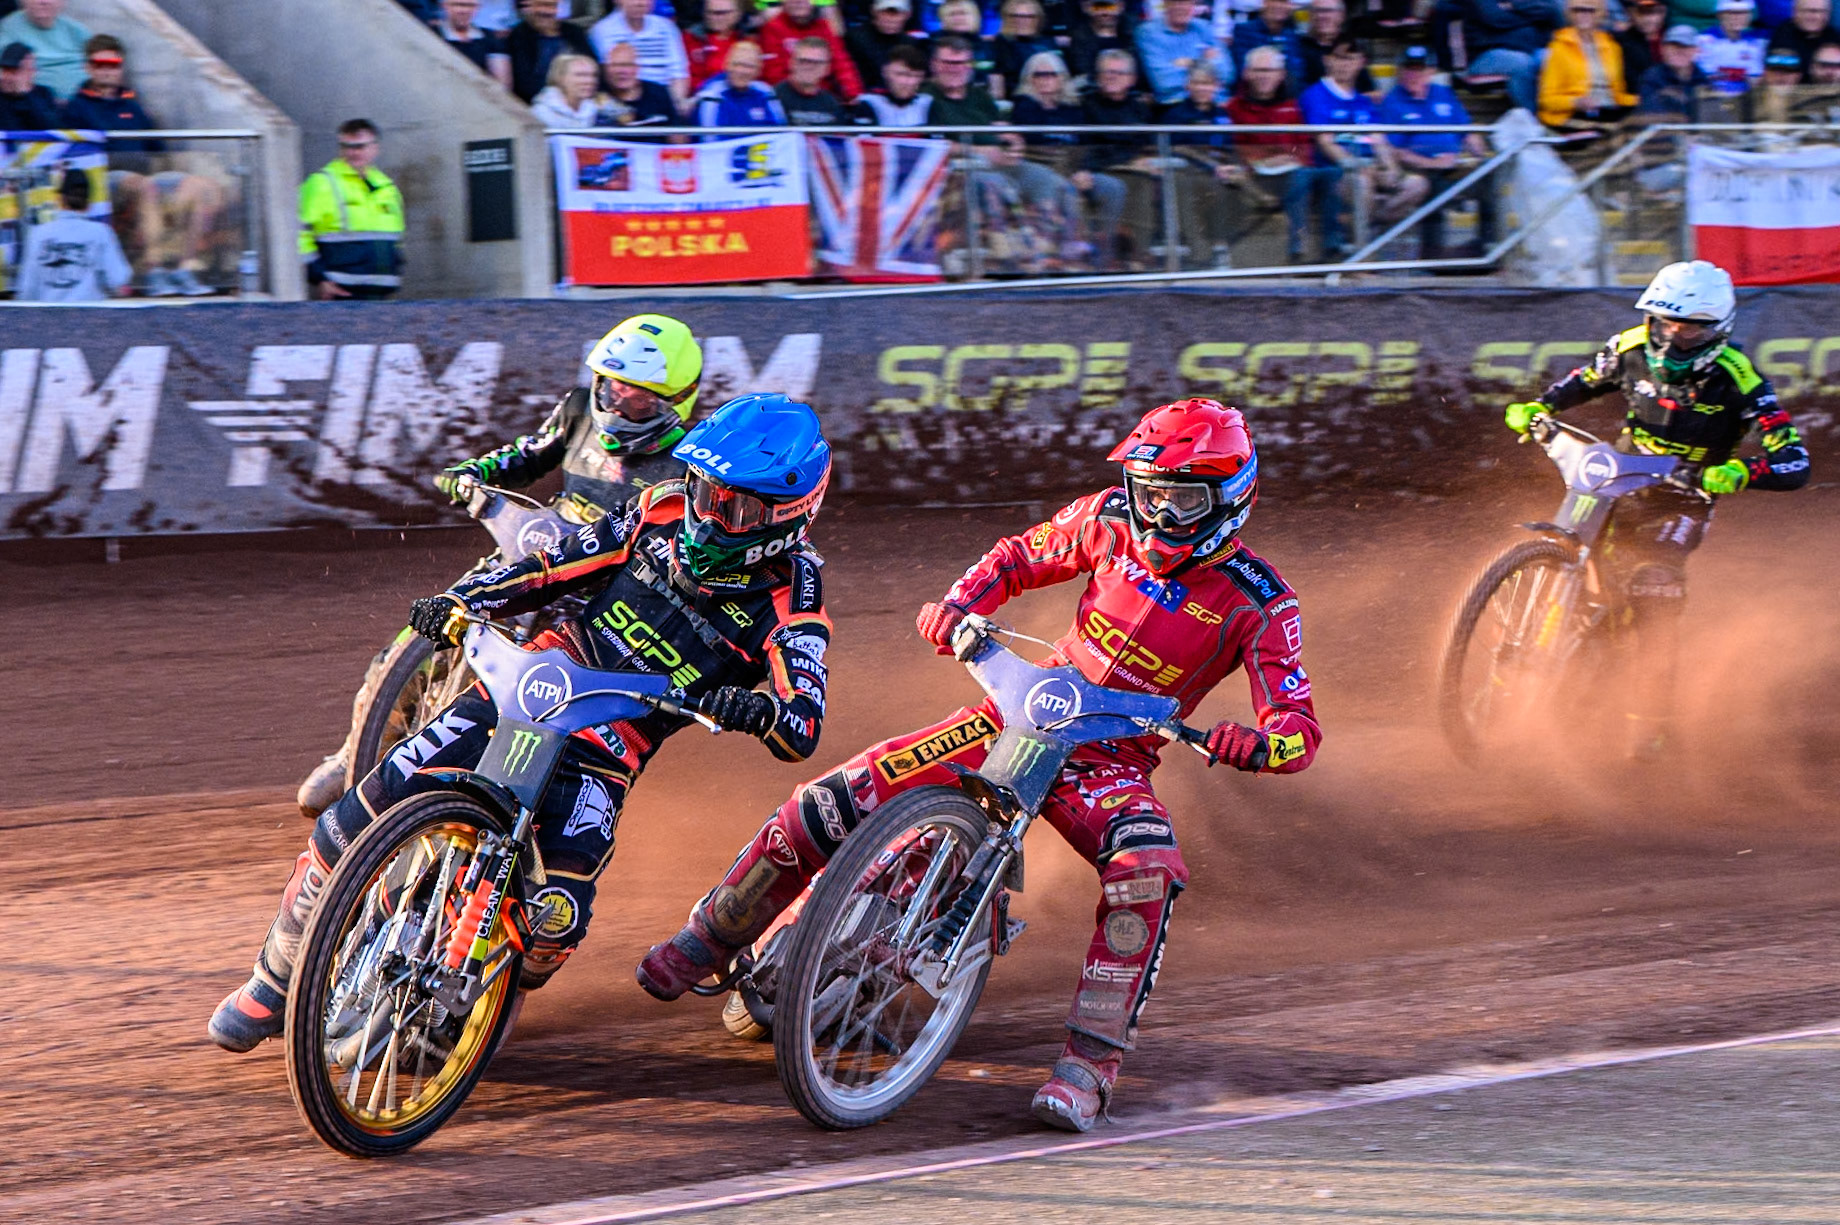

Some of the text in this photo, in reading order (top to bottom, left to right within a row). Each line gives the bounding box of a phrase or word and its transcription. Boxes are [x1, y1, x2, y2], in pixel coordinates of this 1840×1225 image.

[610, 233, 748, 257] POLSKA
[190, 341, 504, 487] FIM
[676, 443, 733, 475] BOLL
[776, 497, 806, 517] OPTY
[745, 524, 807, 566] BOLL
[601, 627, 633, 659] SPEEDWAY
[525, 679, 564, 703] ATPI
[1114, 666, 1143, 687] GRAND
[1032, 692, 1072, 716] ATPI
[917, 717, 988, 762] ENTRAC
[773, 833, 794, 860] ATPI
[477, 889, 501, 938] CLEAN
